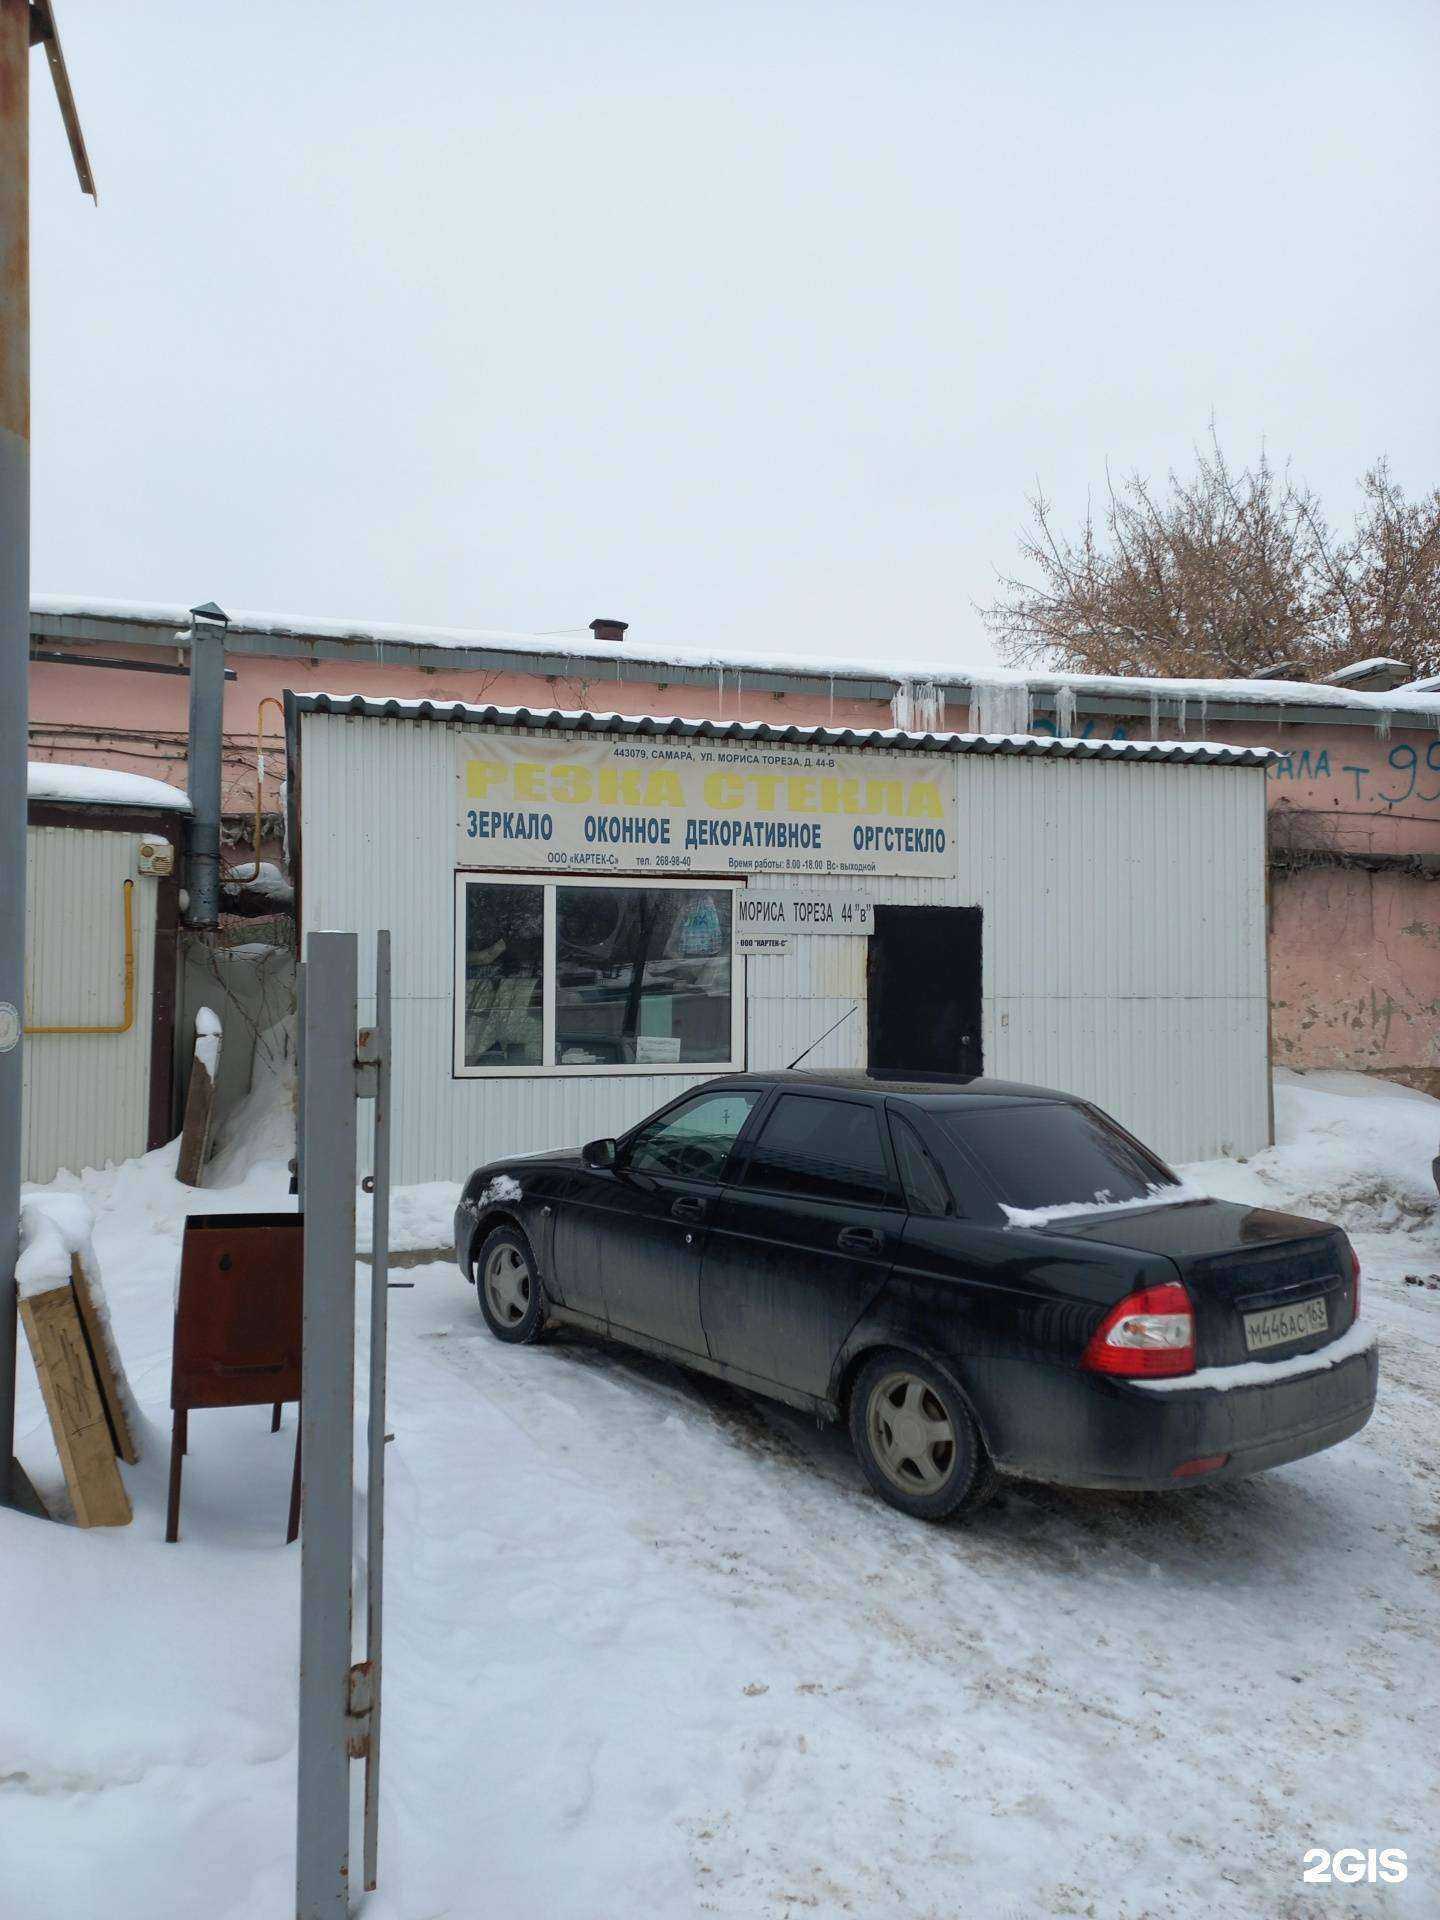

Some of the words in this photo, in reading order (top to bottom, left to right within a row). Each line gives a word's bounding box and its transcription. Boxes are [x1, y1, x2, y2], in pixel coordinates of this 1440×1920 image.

[614, 749, 648, 760] 443079,
[651, 750, 696, 762] САМАРА,
[700, 753, 715, 762] УЛ.
[718, 754, 759, 764] МОРИСА
[815, 758, 835, 768] 44-В
[1266, 750, 1331, 780] АЛА
[466, 760, 687, 807] РЕЗКА
[703, 772, 945, 819] СТЕКЛА
[467, 810, 553, 840] ЗЕРКАЛО
[584, 815, 671, 844] ОКОННОЕ
[685, 819, 821, 850] ДЕКОРАТИВНОЕ
[853, 825, 946, 853] ОРГСТЕКЛО
[548, 852, 567, 864] ООО
[636, 857, 651, 866] тел.
[656, 855, 691, 867] 268-98-40
[728, 857, 753, 869] Время
[754, 858, 784, 870] работы:
[840, 862, 876, 872] выходной
[739, 902, 785, 922] МОРИСА
[793, 903, 833, 922] ТОРЕЗА
[740, 939, 753, 947] ООО
